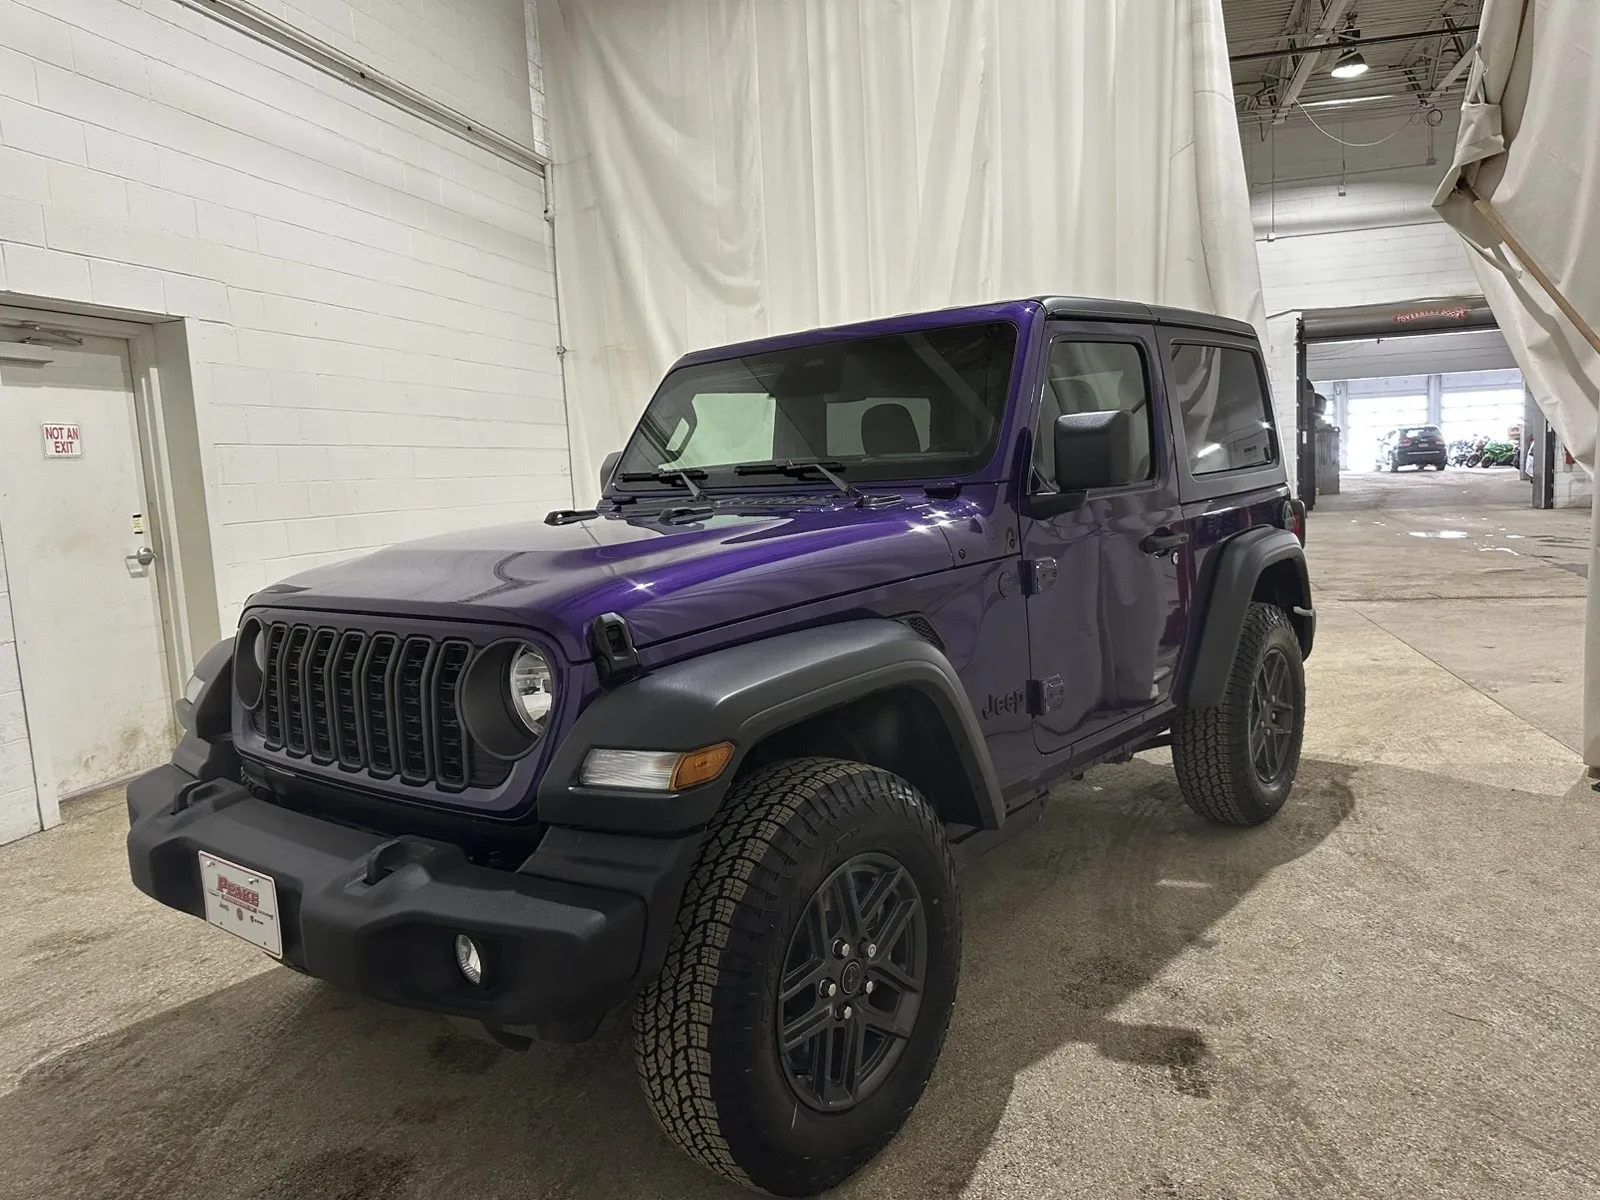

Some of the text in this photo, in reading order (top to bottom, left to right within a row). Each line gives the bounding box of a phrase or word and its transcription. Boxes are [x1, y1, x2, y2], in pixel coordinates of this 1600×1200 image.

[45, 427, 79, 440] NOT AN
[54, 441, 74, 454] EXIT
[981, 688, 1023, 721] Jeep
